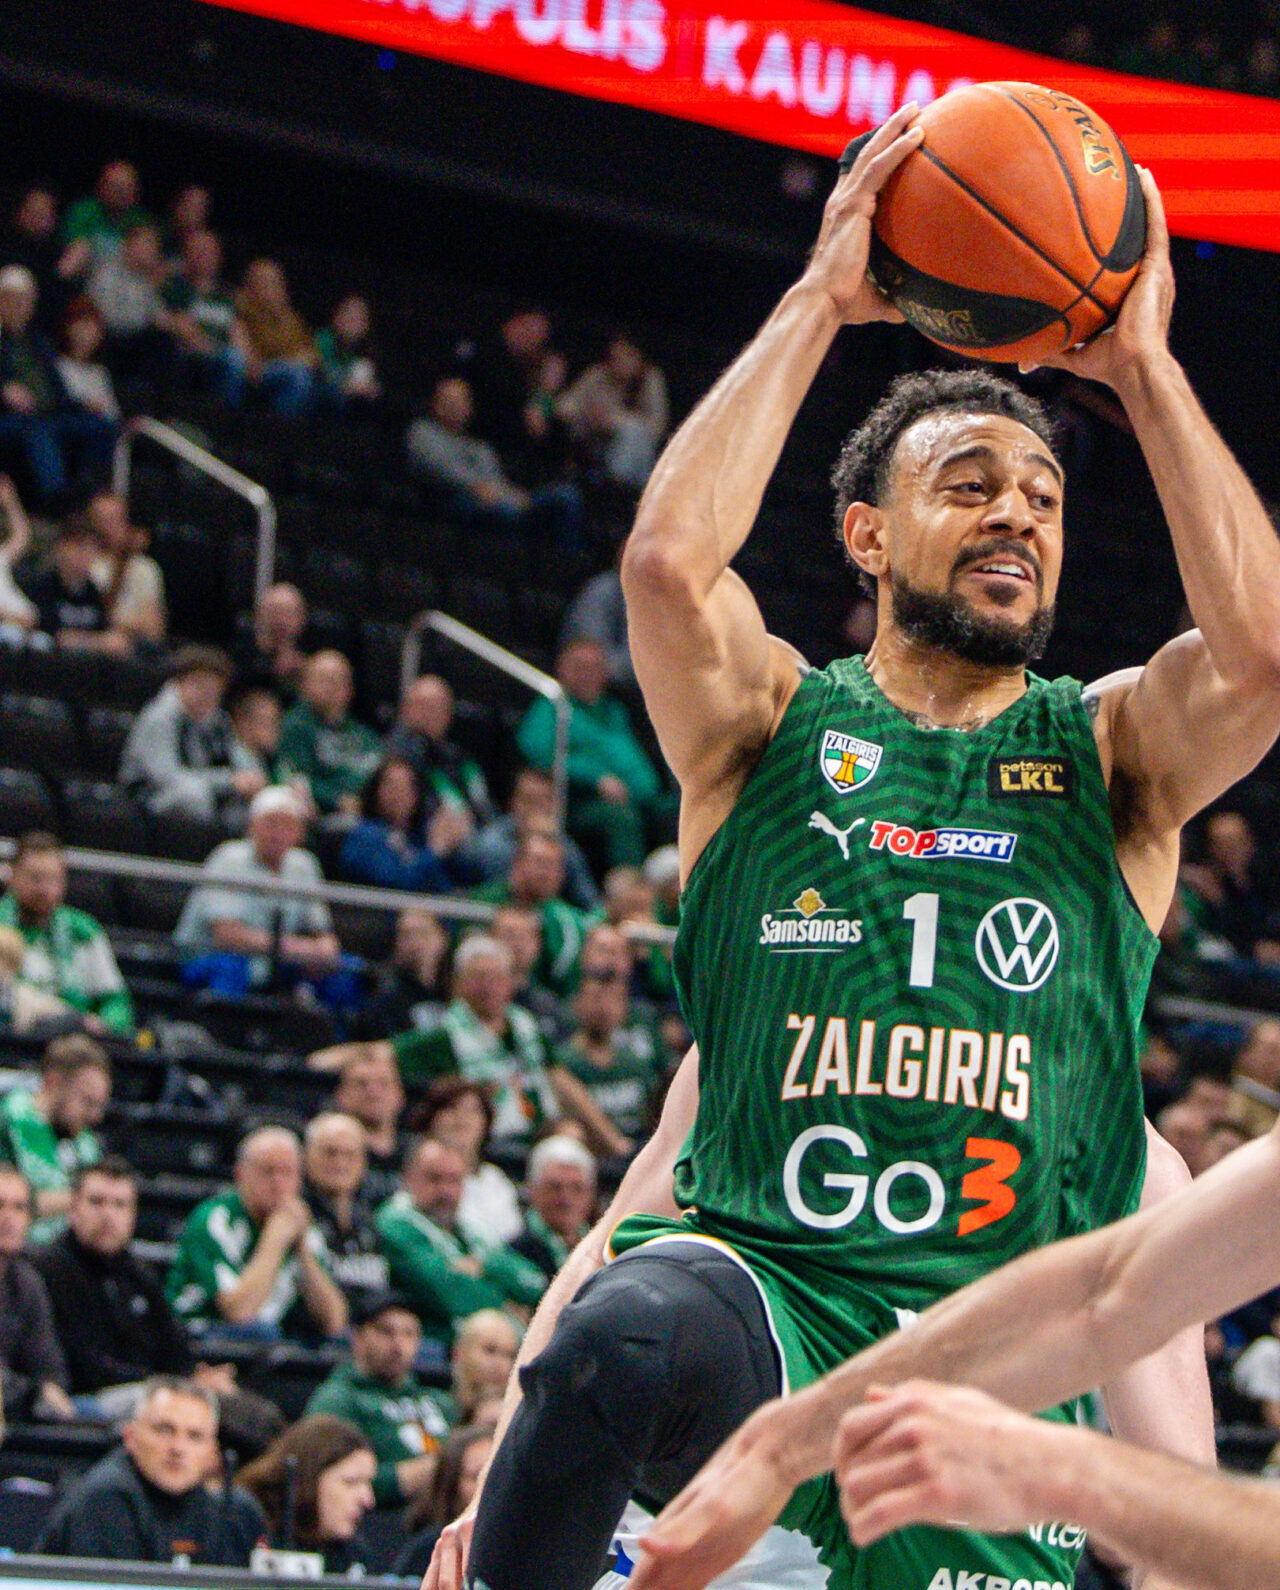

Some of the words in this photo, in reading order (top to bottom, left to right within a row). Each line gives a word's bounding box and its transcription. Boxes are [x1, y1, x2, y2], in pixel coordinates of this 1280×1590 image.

[702, 15, 978, 127] KAUNA
[1001, 771, 1064, 792] LKL
[759, 914, 863, 944] Samsonas
[903, 892, 940, 988] 1
[783, 1124, 1021, 1237] Go3
